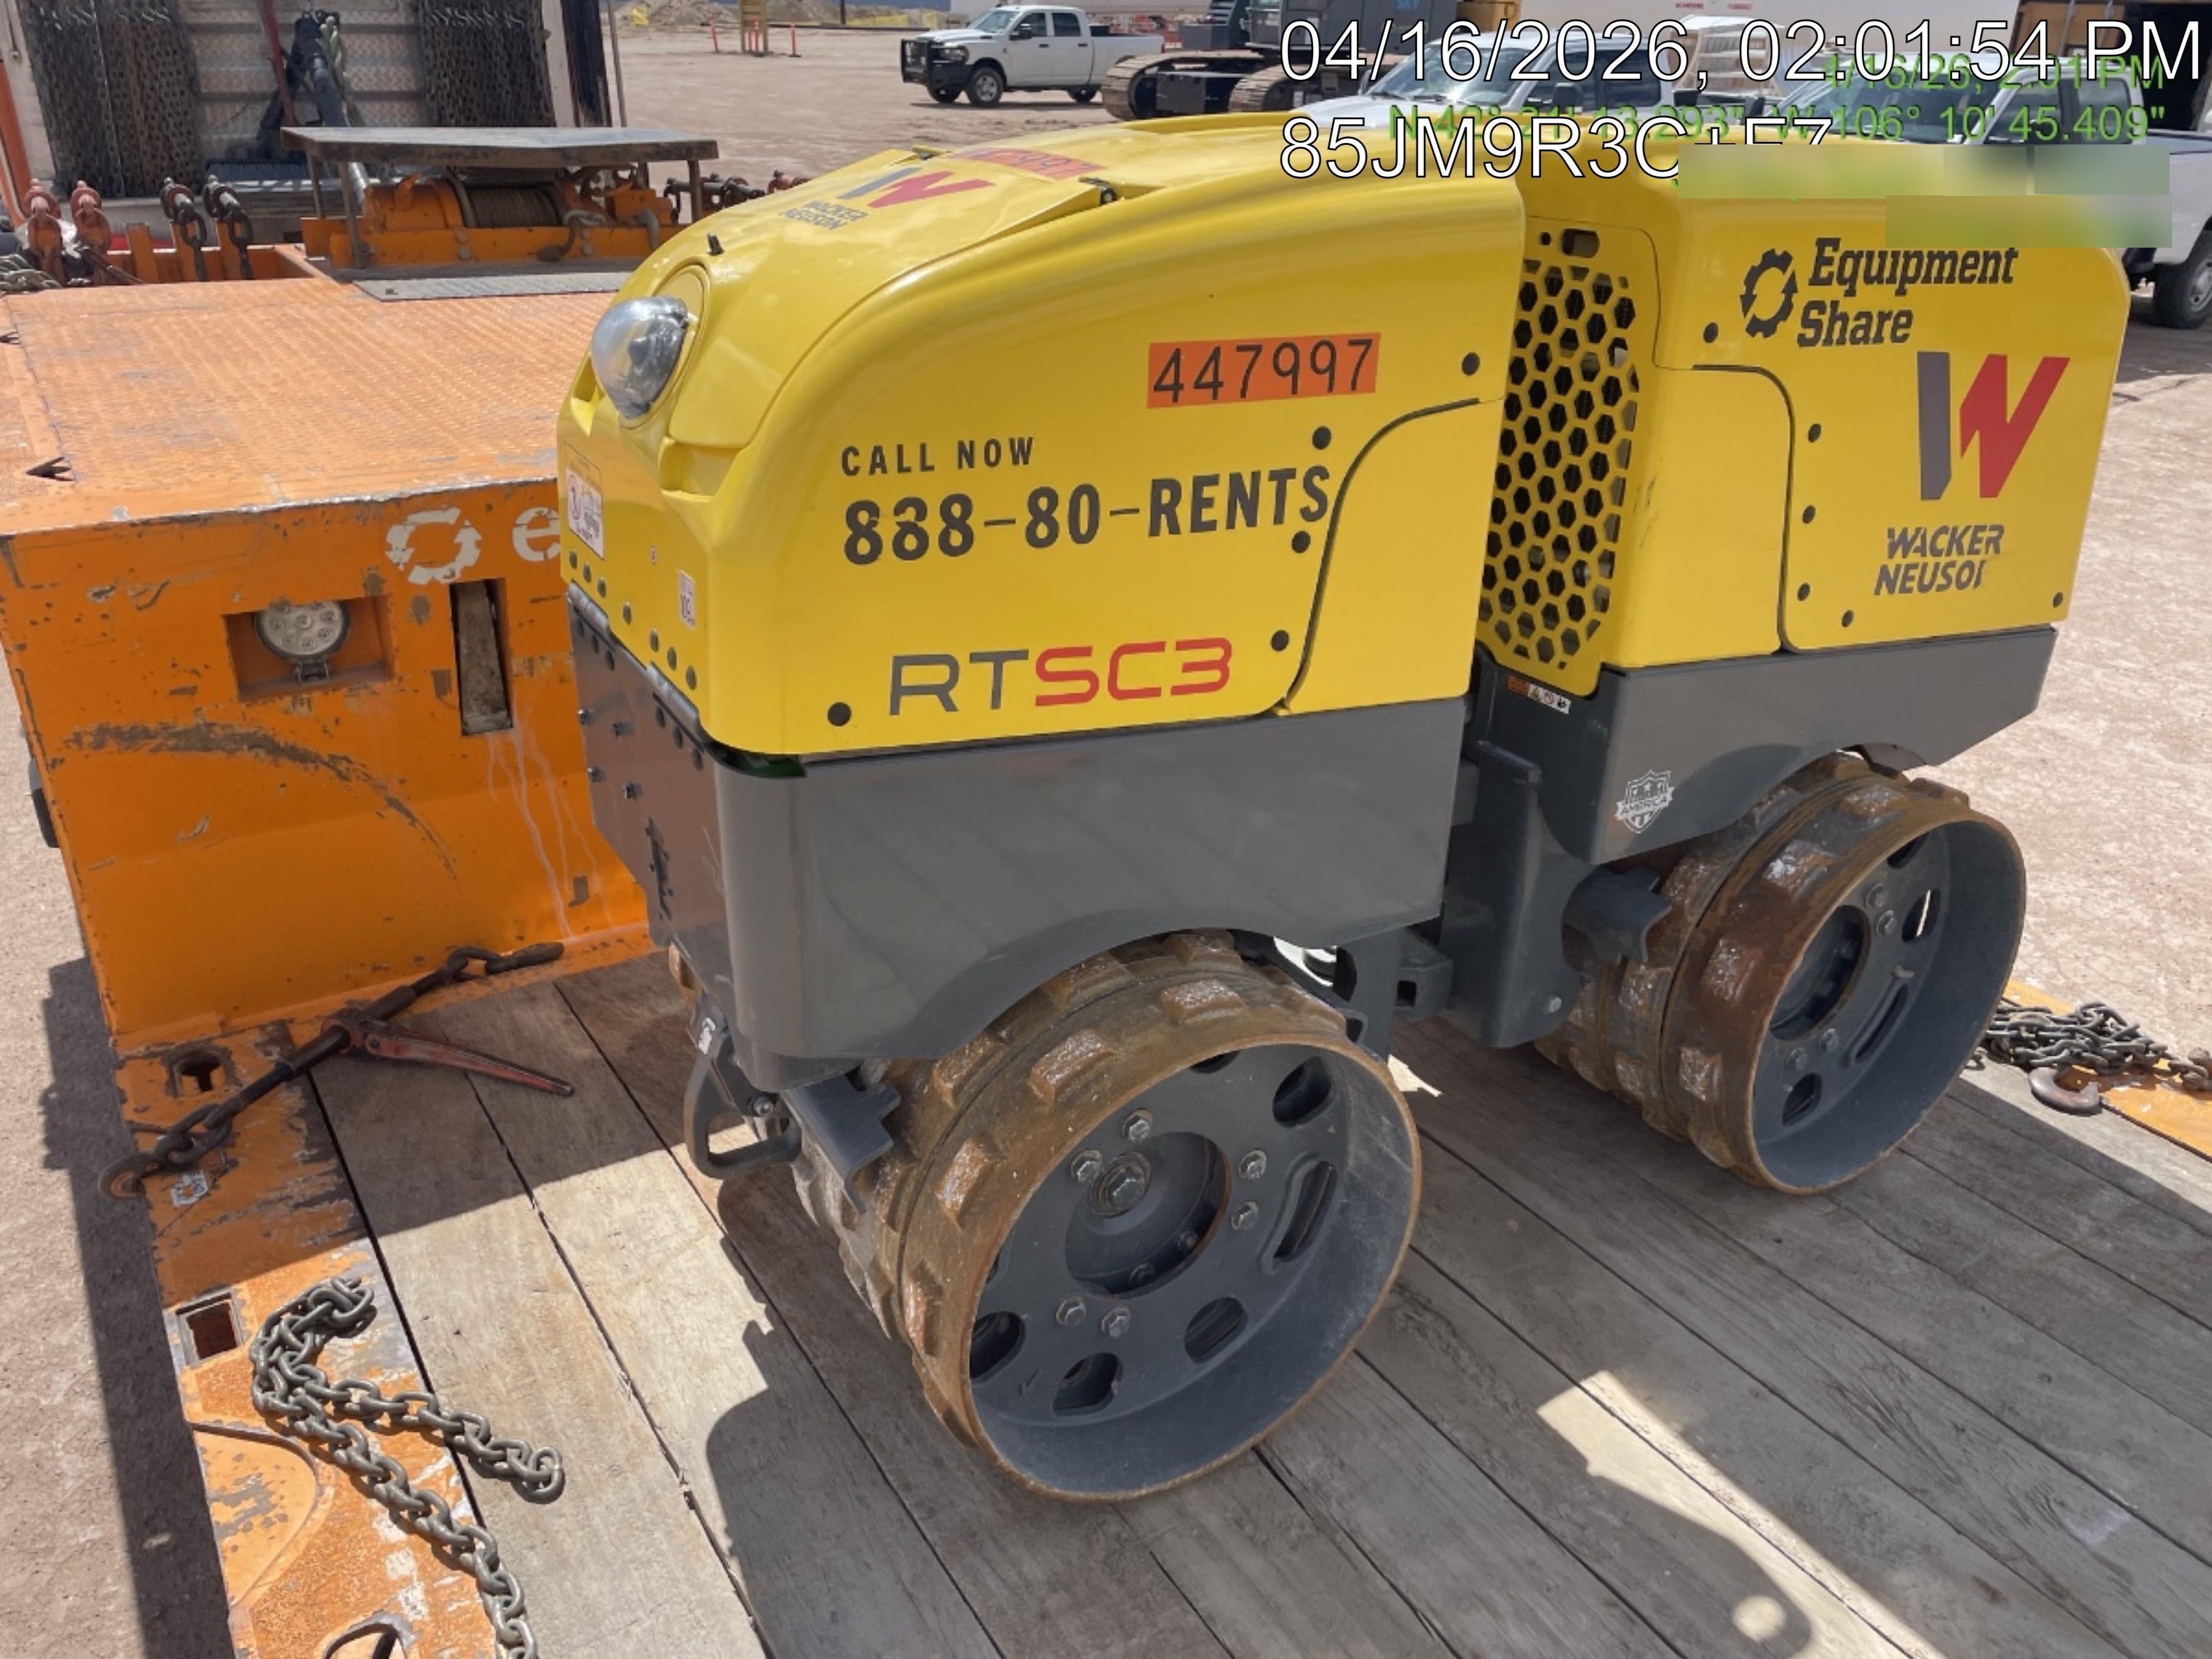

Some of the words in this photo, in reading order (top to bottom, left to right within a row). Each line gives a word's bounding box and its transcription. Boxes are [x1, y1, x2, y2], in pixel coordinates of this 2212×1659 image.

[1808, 237, 2018, 297] Equipment
[1797, 300, 1913, 348] Share
[1153, 339, 1373, 403] 447997
[842, 442, 935, 477] CALL
[957, 436, 1033, 469] NOW
[1886, 524, 2005, 559] WACKER
